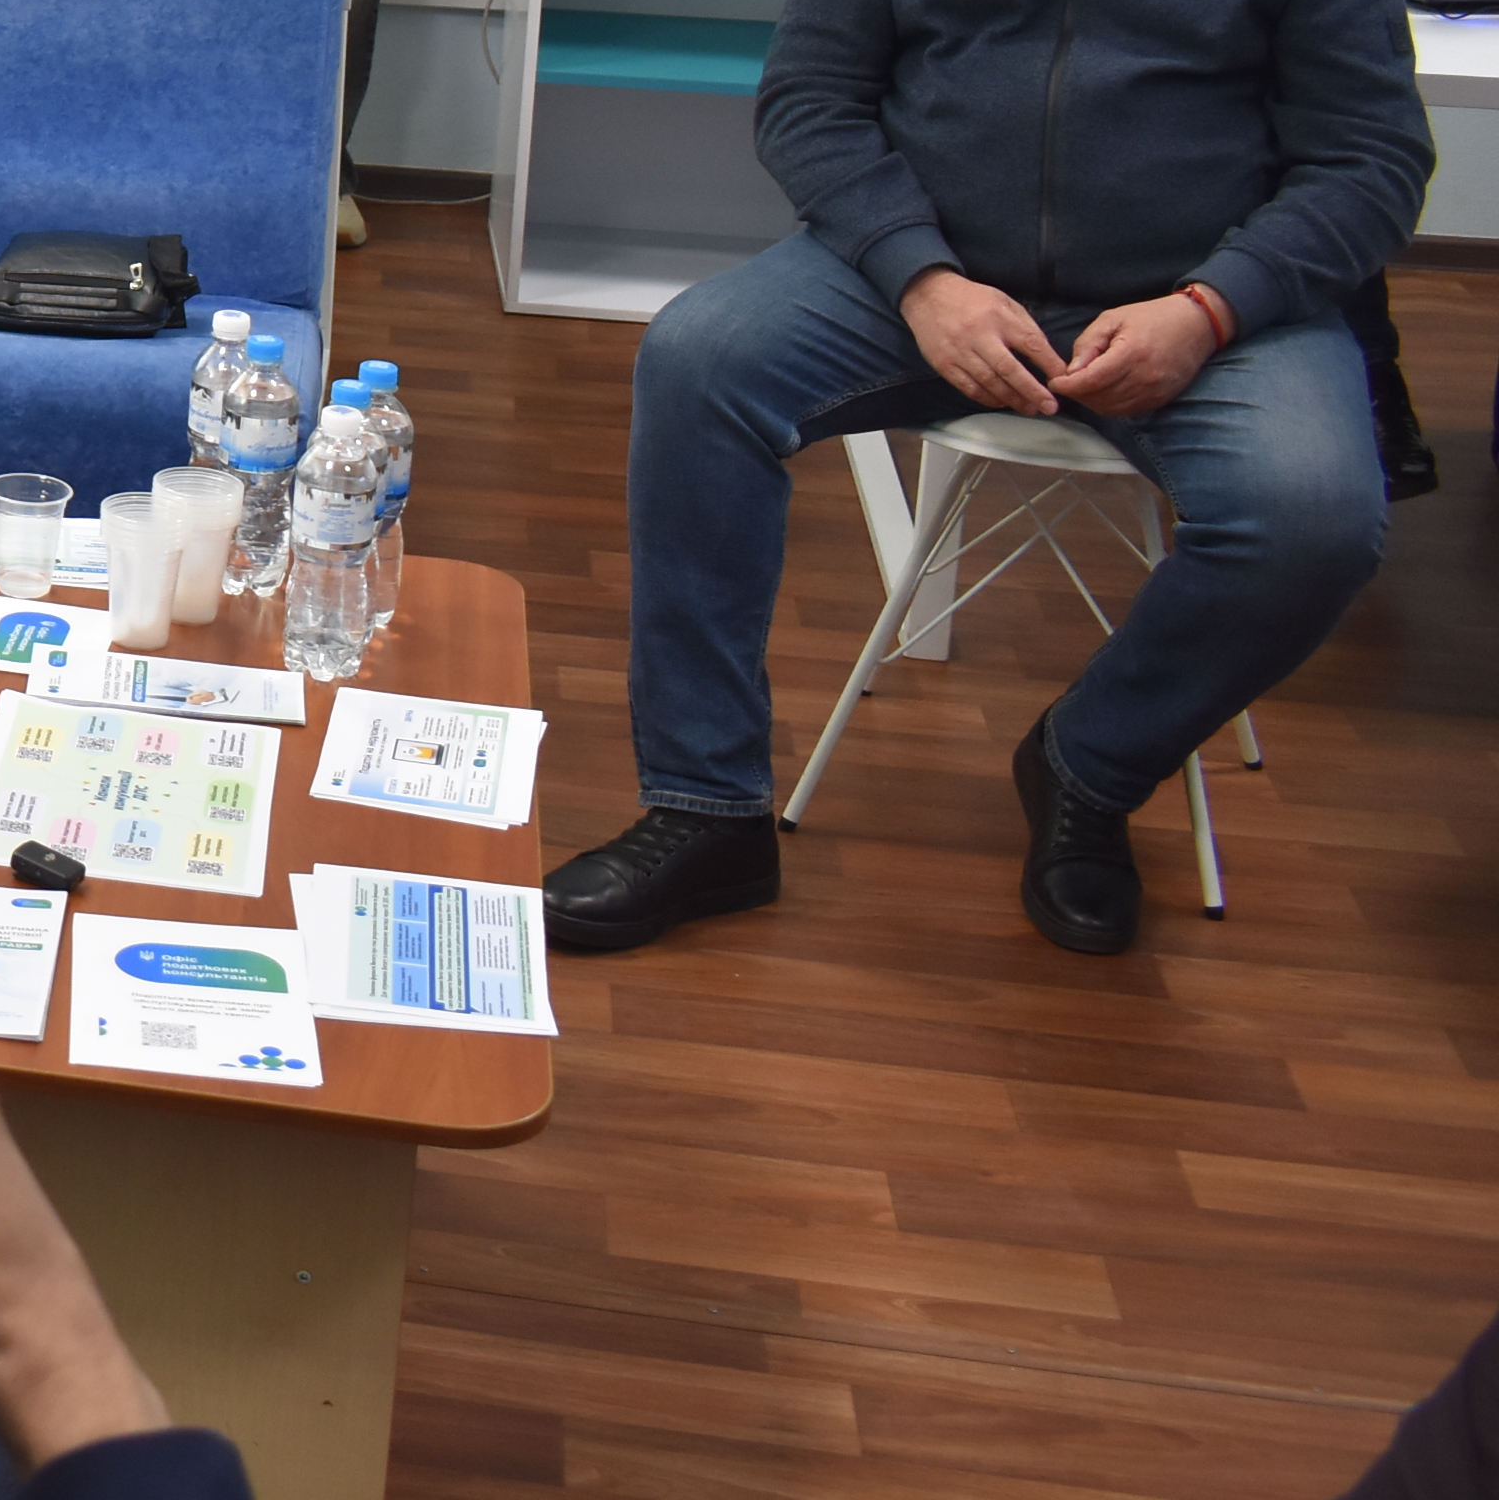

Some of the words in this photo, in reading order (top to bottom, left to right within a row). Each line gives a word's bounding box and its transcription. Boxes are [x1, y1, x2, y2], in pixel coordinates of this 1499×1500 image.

[161, 953, 198, 963] Офіс
[162, 961, 248, 975] податкових
[162, 968, 268, 983] консультантів
